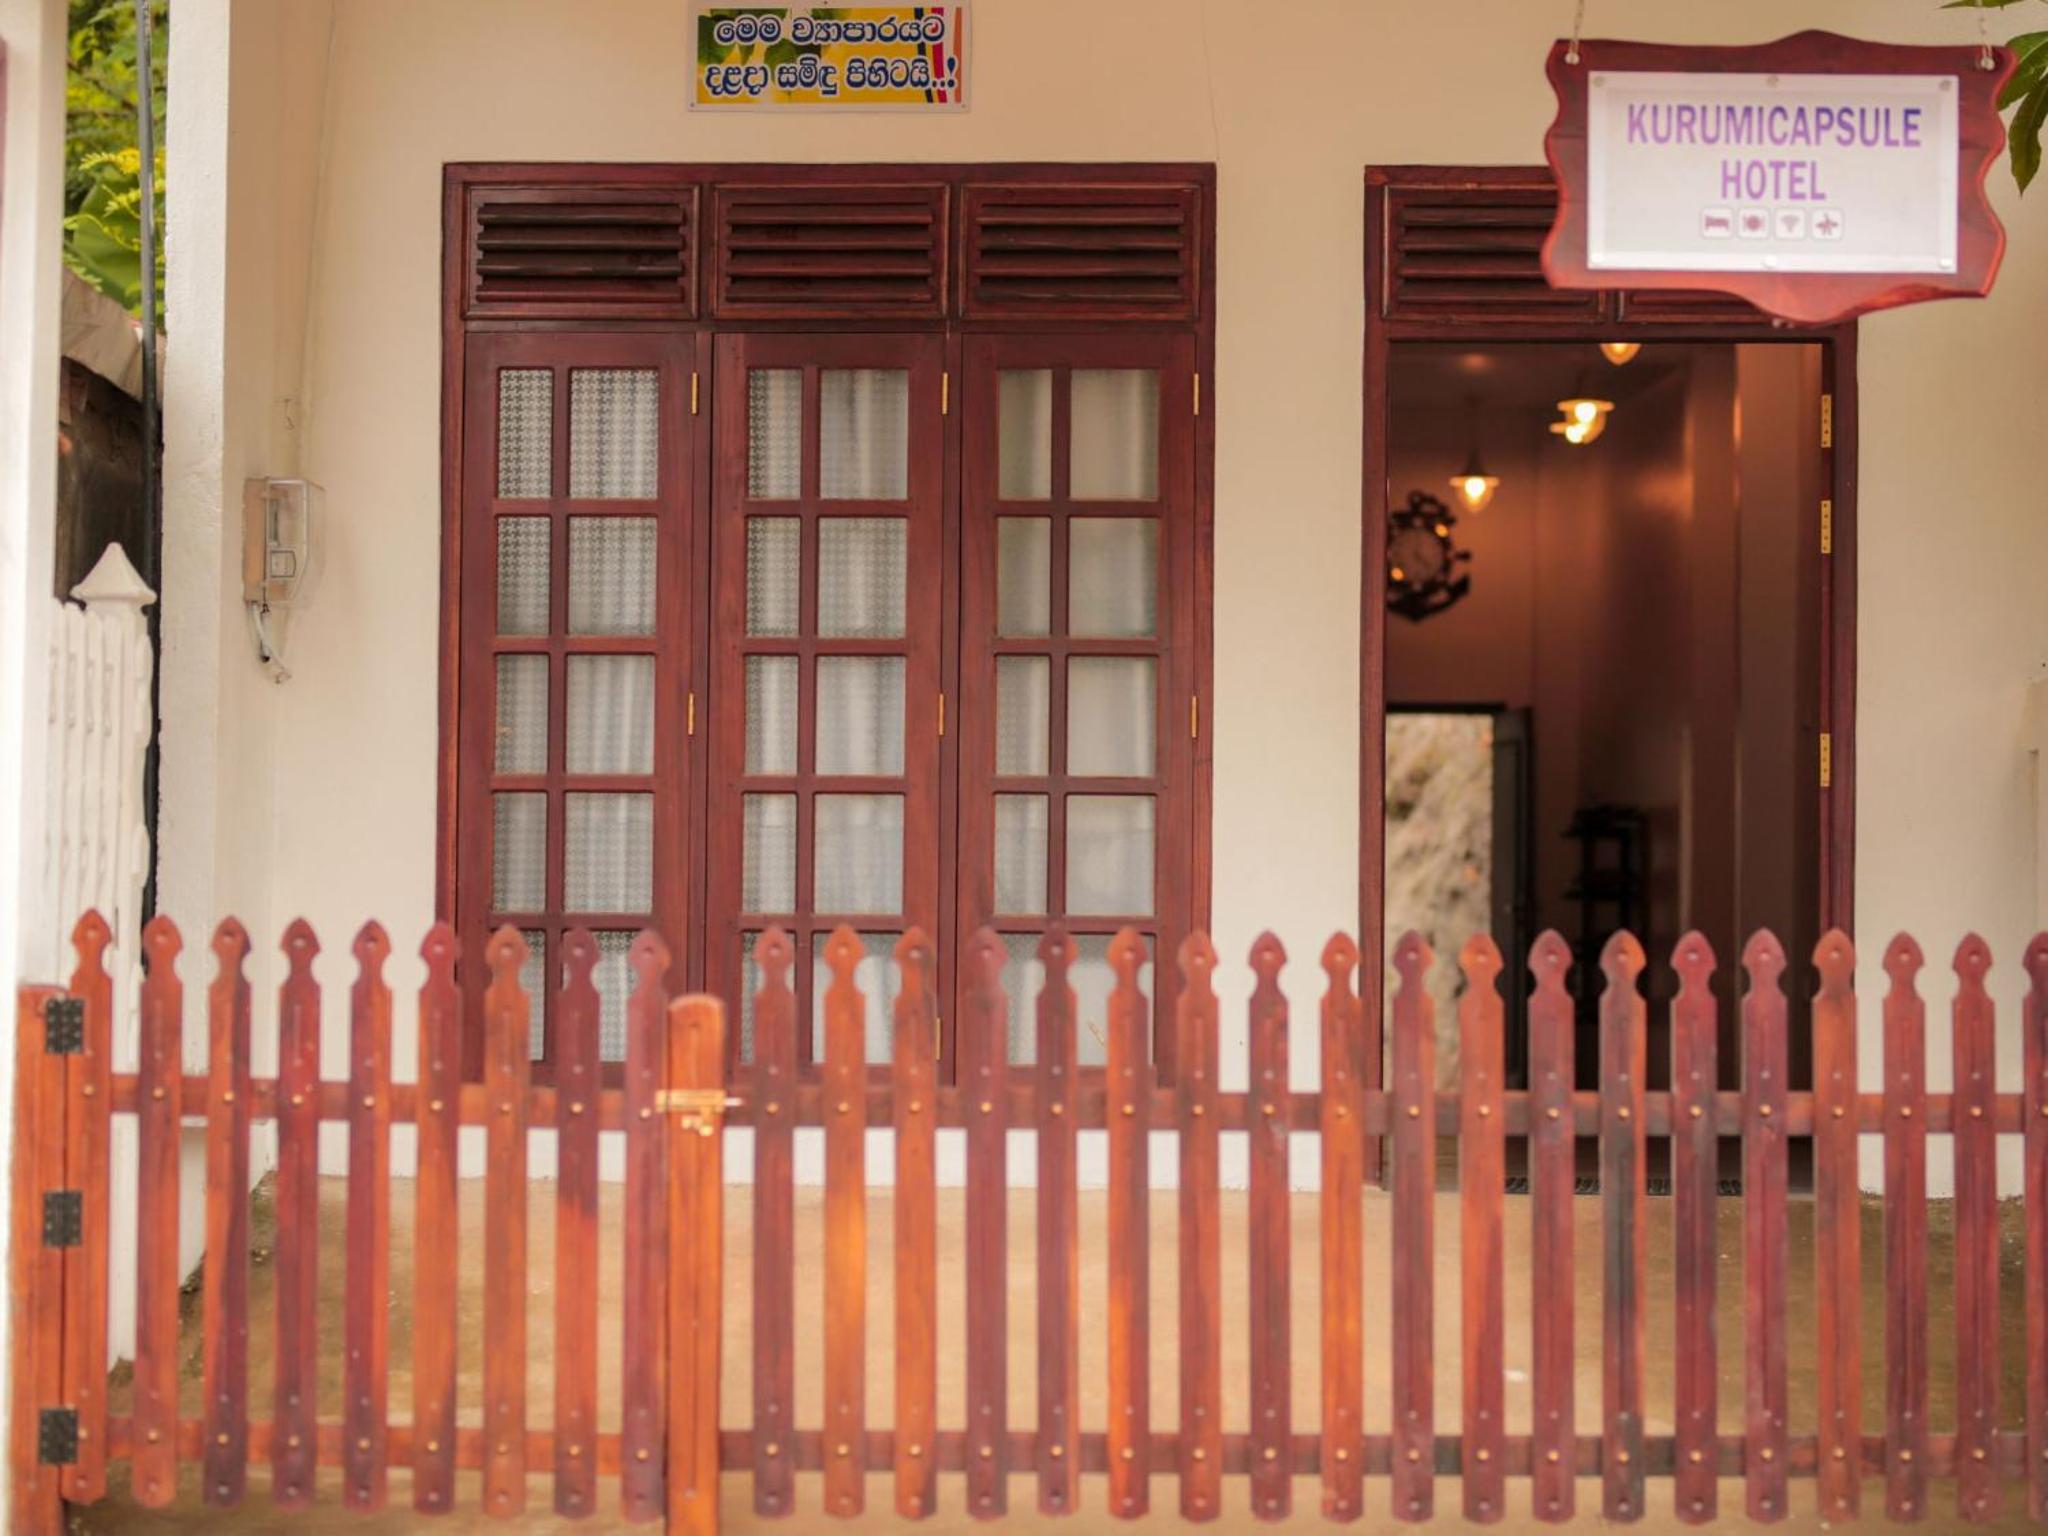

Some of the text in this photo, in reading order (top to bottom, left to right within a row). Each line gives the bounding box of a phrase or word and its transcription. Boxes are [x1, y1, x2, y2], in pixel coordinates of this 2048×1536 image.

[715, 16, 782, 43] මෙම
[704, 64, 769, 96] දළදා
[1627, 104, 1922, 147] KURUMICAPSULE
[1720, 159, 1827, 200] HOTEL
